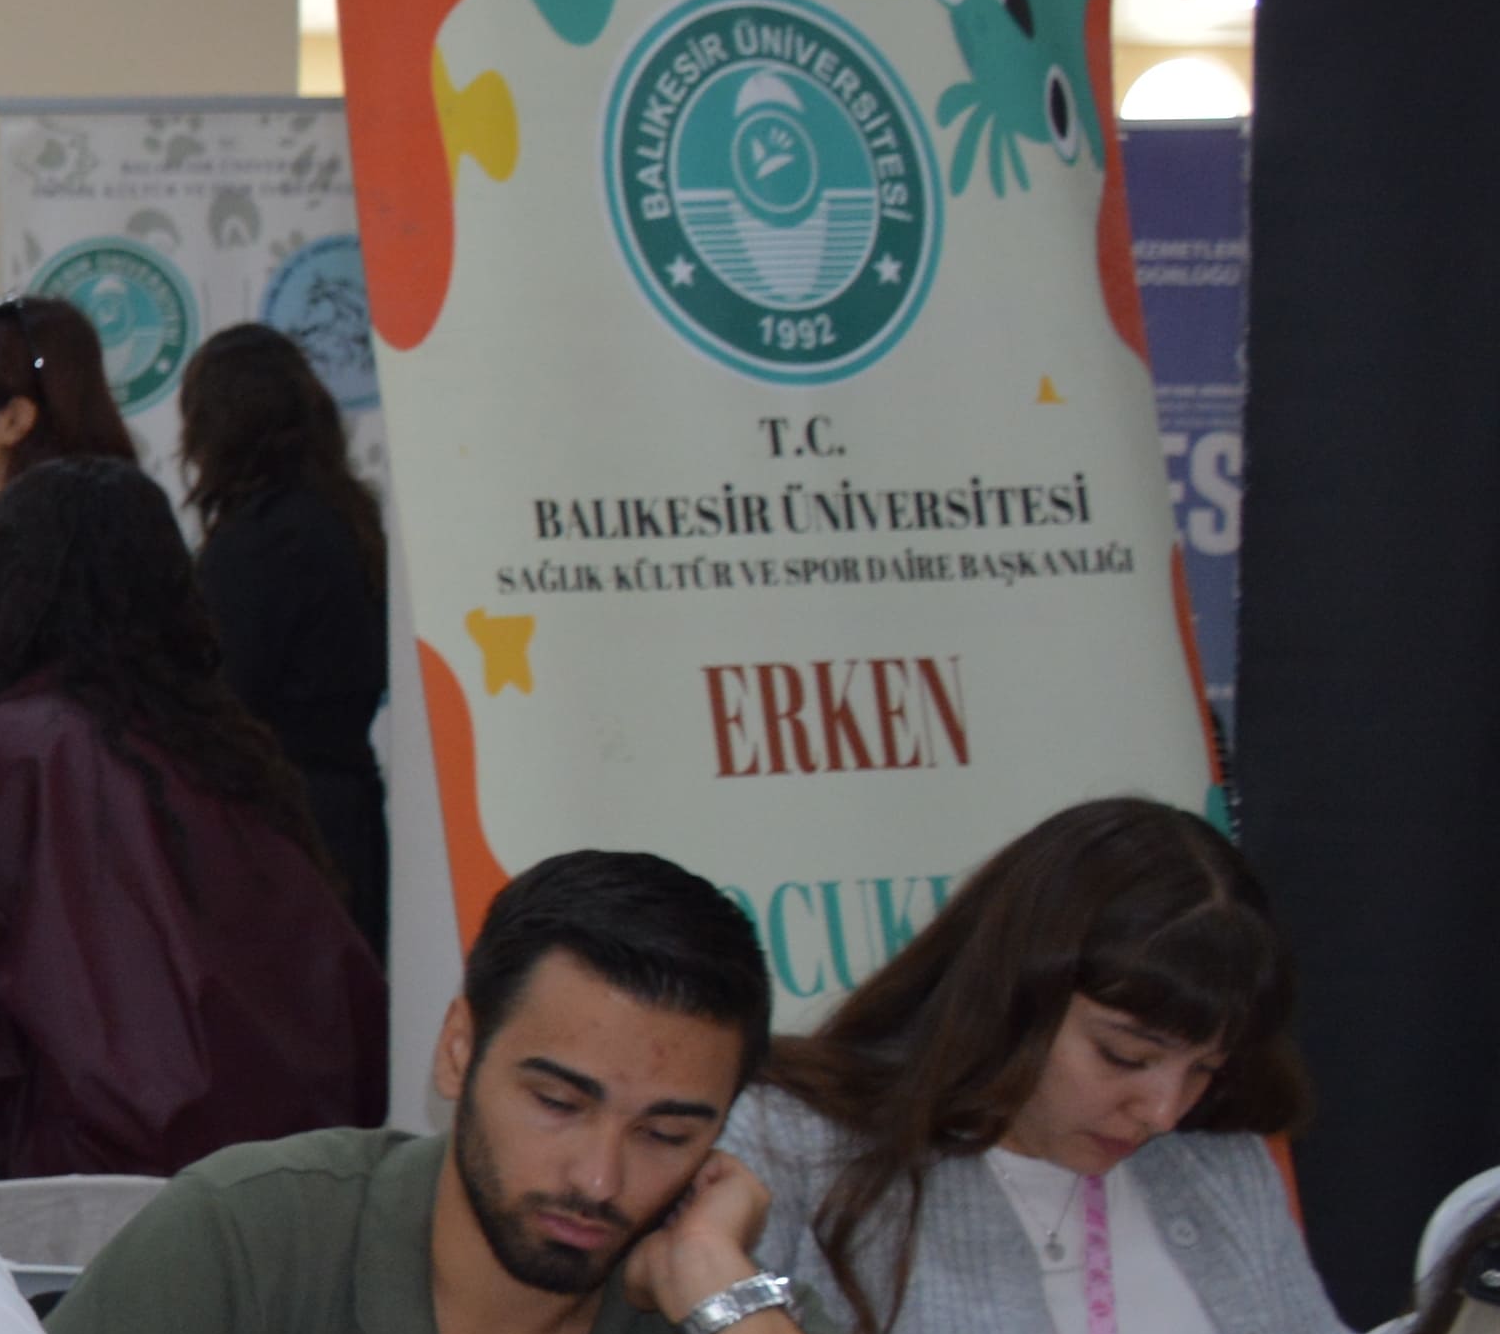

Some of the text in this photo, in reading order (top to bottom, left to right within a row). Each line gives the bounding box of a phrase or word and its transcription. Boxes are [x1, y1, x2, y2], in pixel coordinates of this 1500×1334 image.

[638, 19, 913, 223] BALIKESİR ÜNİVERSİTESİ
[759, 314, 838, 350] 1992
[758, 415, 847, 458] T.C.
[533, 472, 1091, 540] BALIKESİR ÜNİVERSİTESİ
[739, 561, 780, 586] VE
[786, 555, 861, 585] SPOR
[866, 547, 954, 583] DAİRE
[958, 540, 1135, 587] BAŞKANLIĞI
[700, 654, 971, 779] ERKEN
